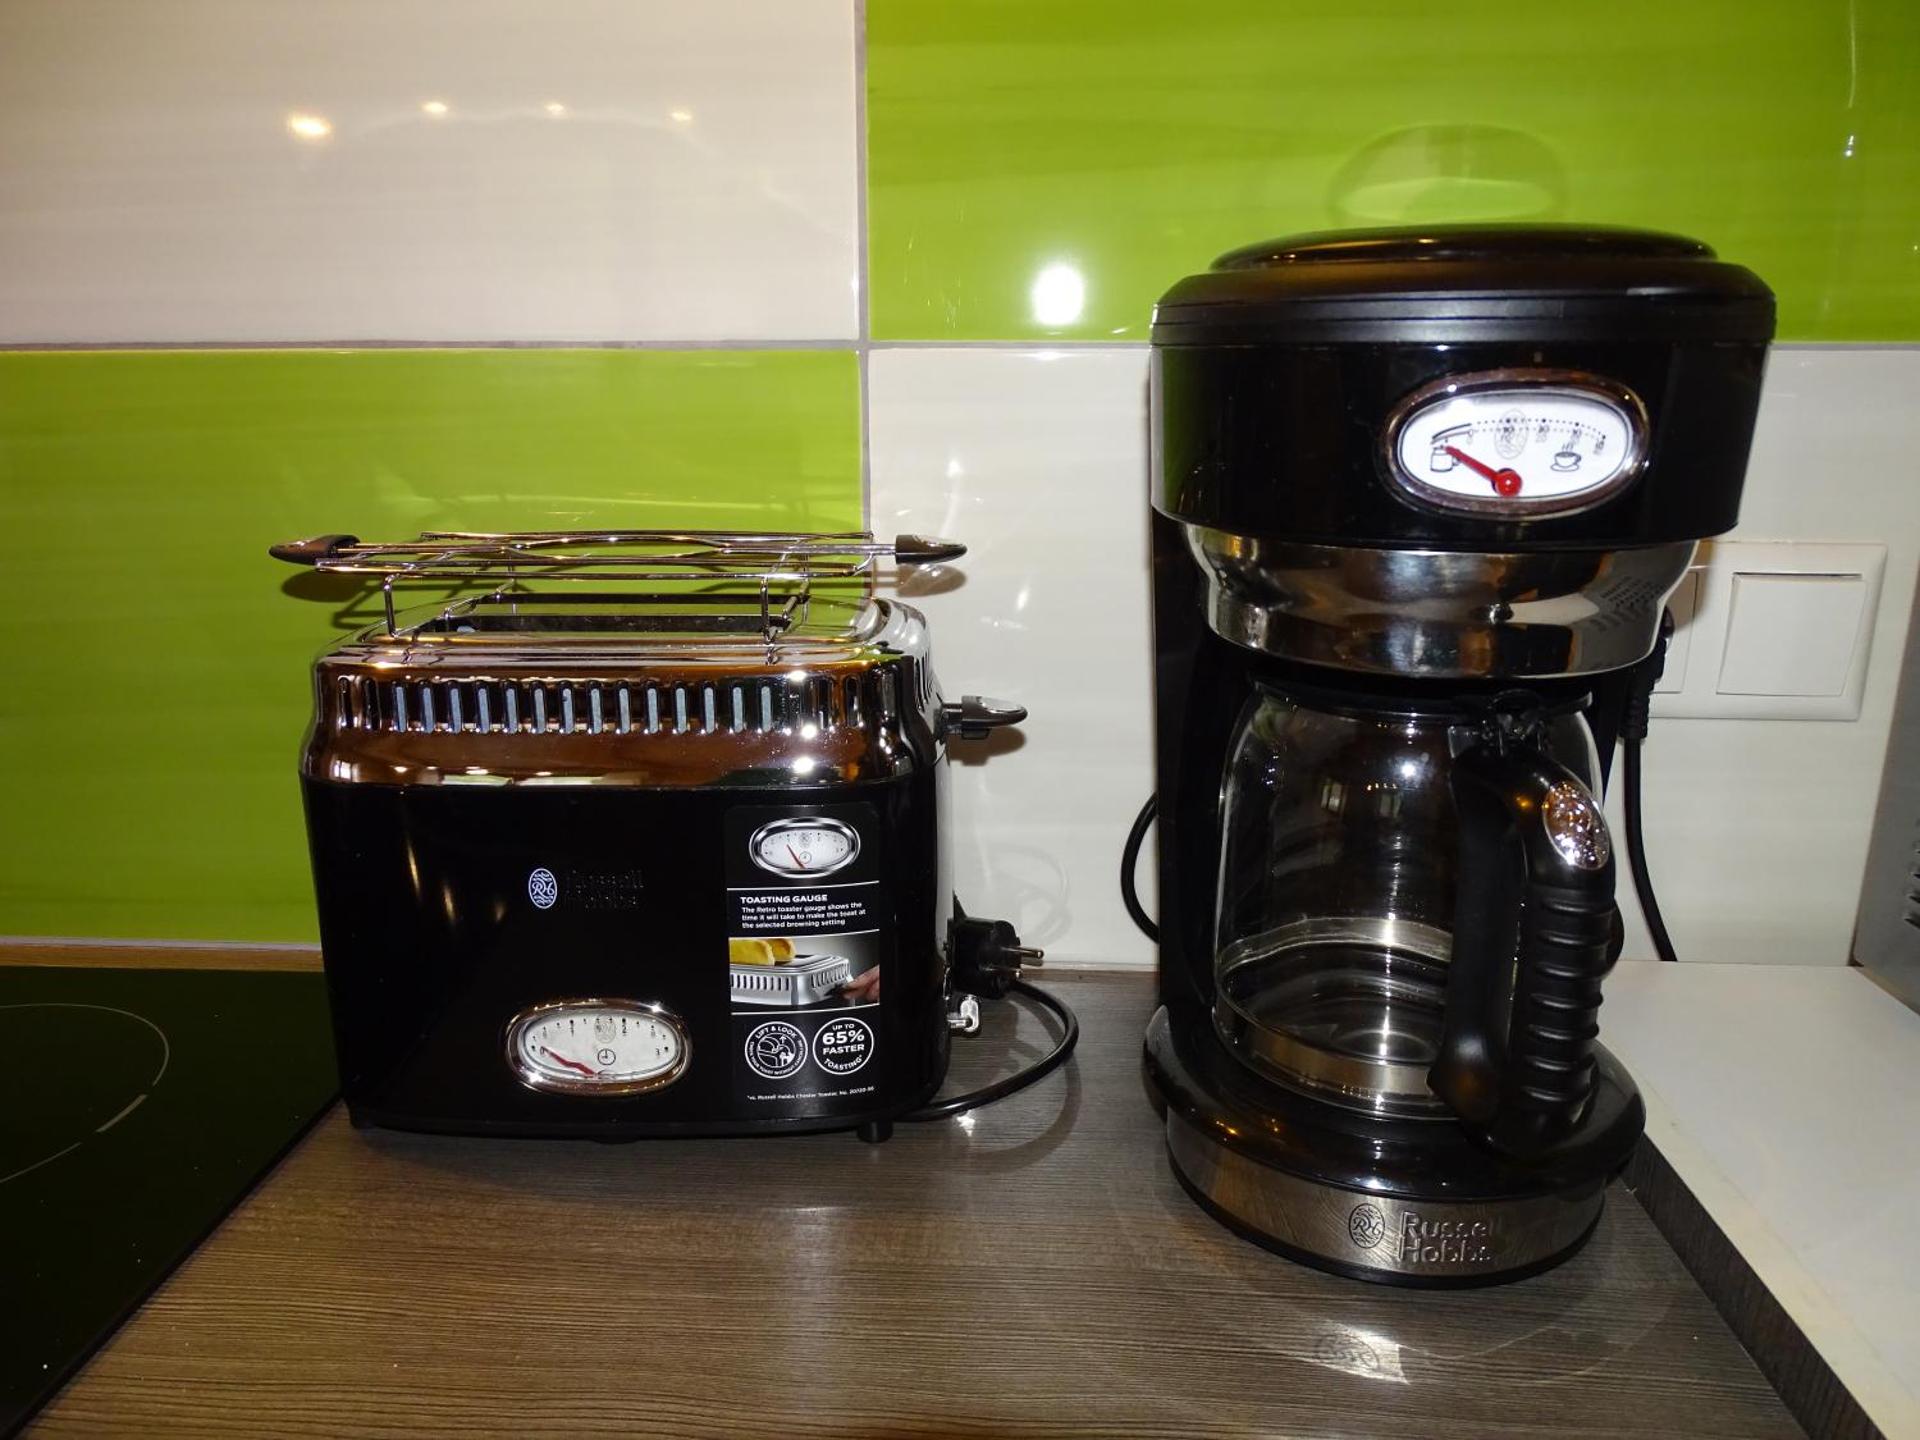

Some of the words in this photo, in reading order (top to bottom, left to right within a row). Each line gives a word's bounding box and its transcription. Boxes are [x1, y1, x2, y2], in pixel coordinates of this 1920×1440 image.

[740, 896, 791, 904] TOASTING
[792, 894, 828, 903] GAUGE
[755, 921, 785, 929] selected
[754, 1027, 769, 1039] LIFT
[778, 1026, 797, 1038] LOOK
[822, 1029, 865, 1046] 65%
[822, 1044, 865, 1055] FASTER
